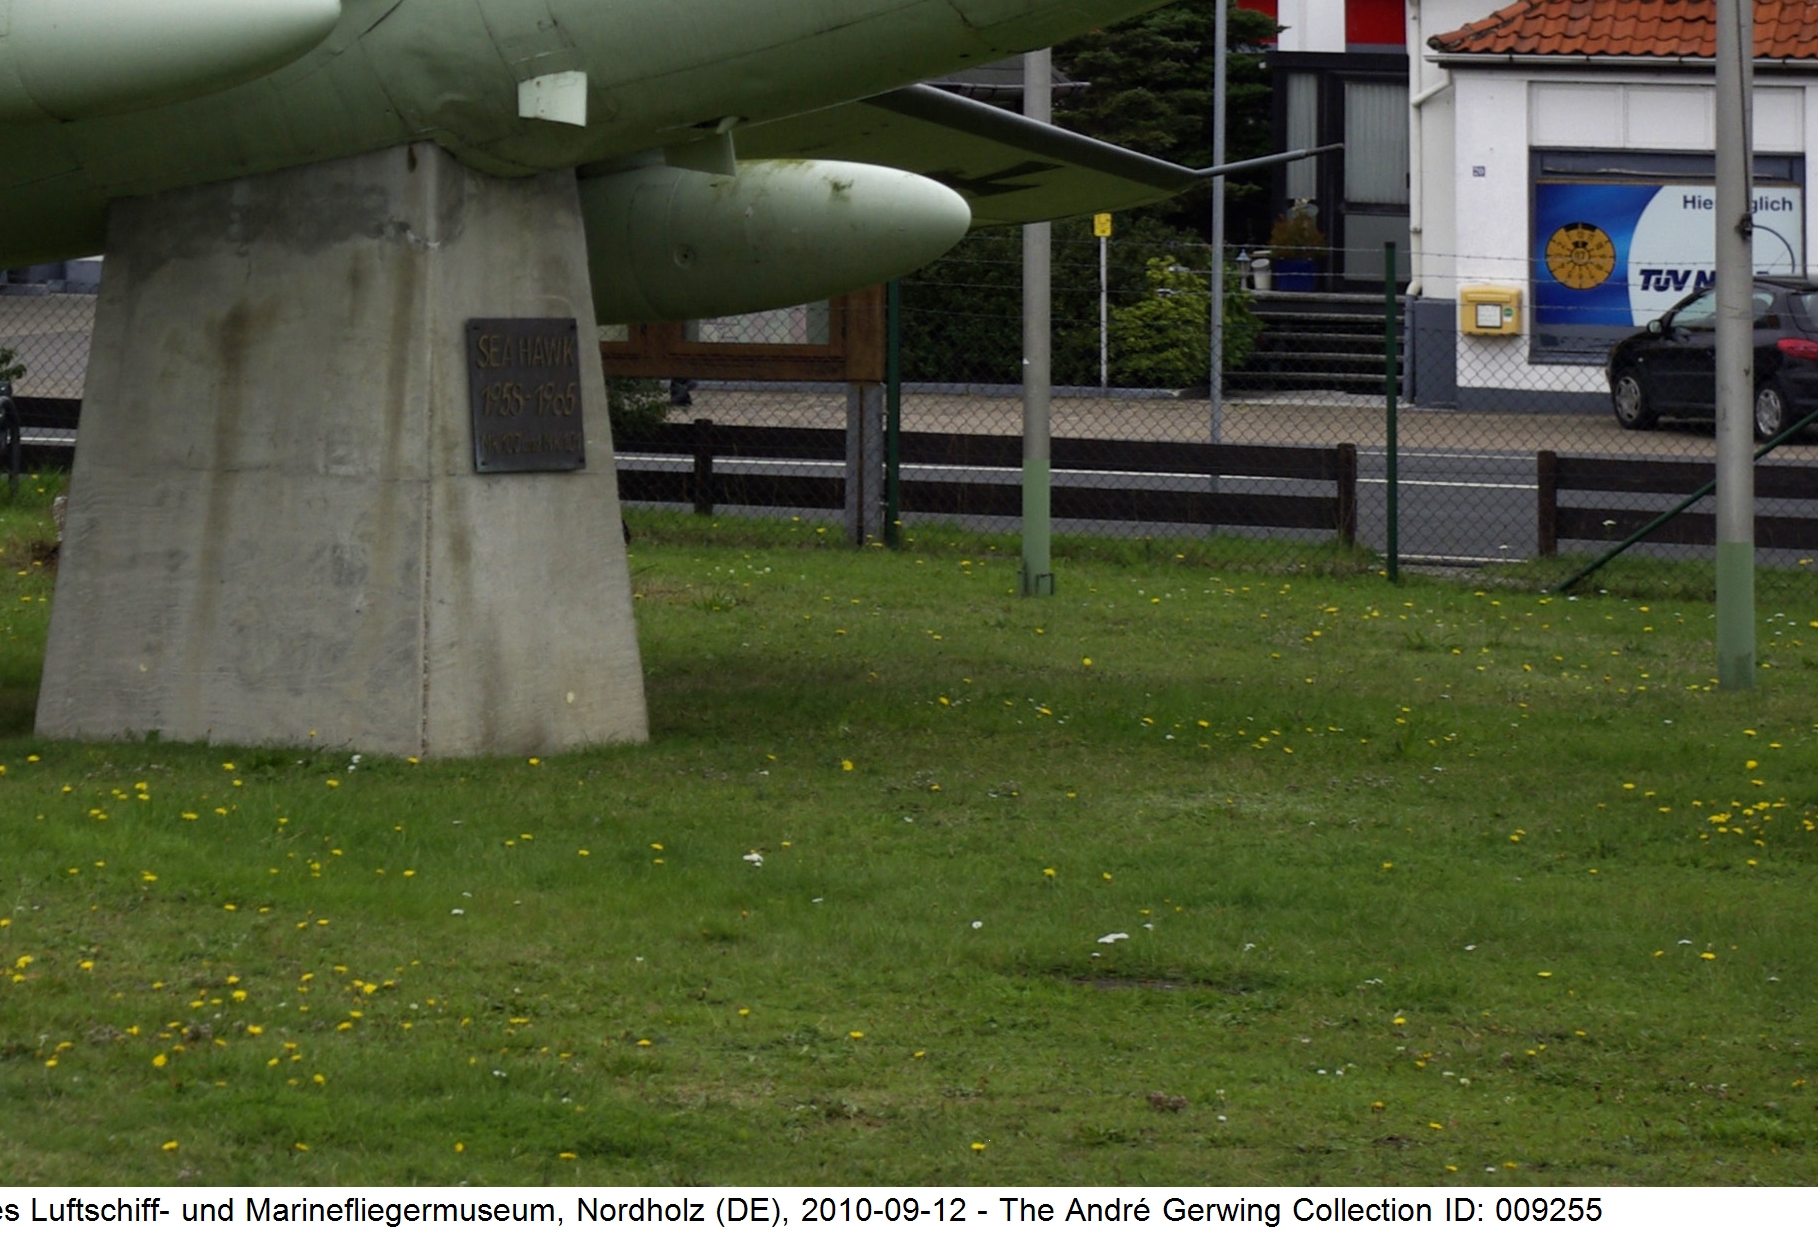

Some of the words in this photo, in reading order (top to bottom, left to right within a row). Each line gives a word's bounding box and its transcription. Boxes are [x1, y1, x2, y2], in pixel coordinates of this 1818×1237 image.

[1683, 195, 1714, 210] Hie
[1639, 269, 1692, 292] TÜV
[476, 334, 512, 368] SEA
[519, 335, 574, 367] HAWK
